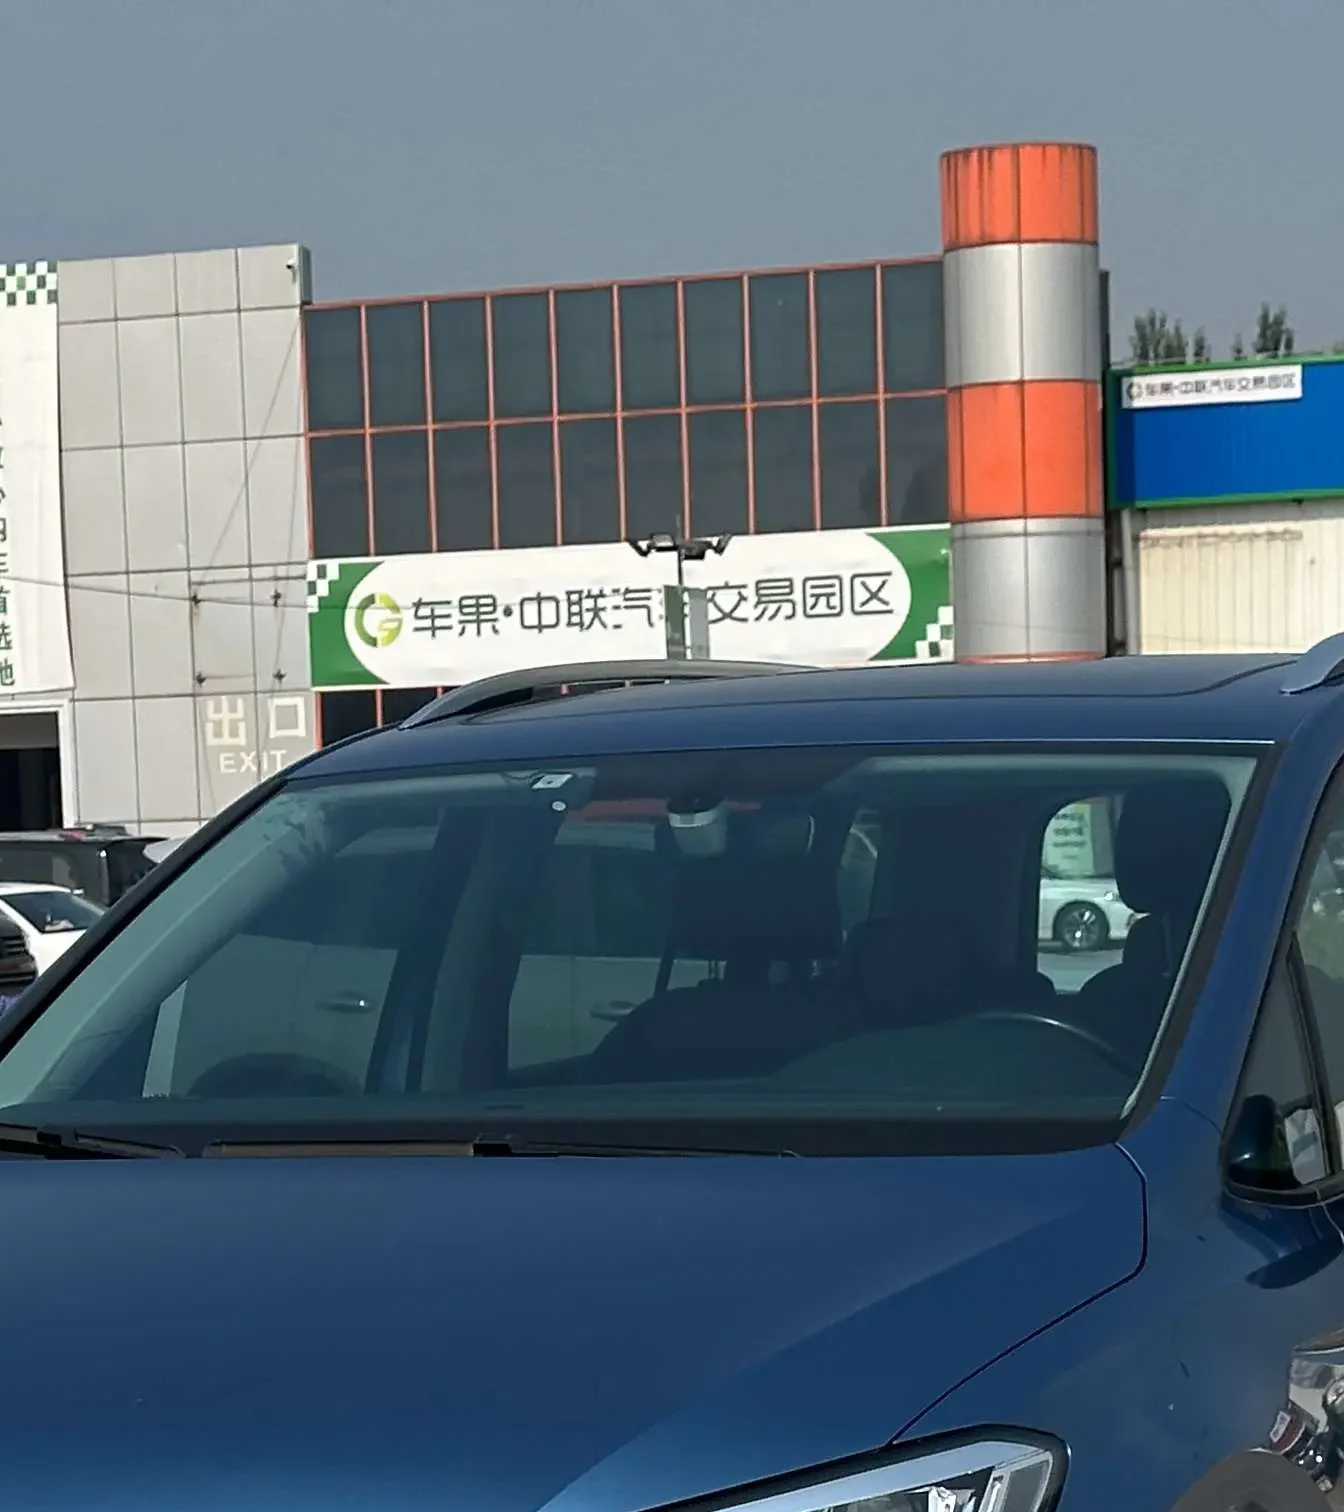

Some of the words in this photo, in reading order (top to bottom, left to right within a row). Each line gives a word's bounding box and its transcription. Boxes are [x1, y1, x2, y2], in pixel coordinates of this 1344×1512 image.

[411, 571, 895, 639] 车果·中联汽交易园区
[205, 696, 306, 747] 出口
[219, 749, 287, 774] EXIT
